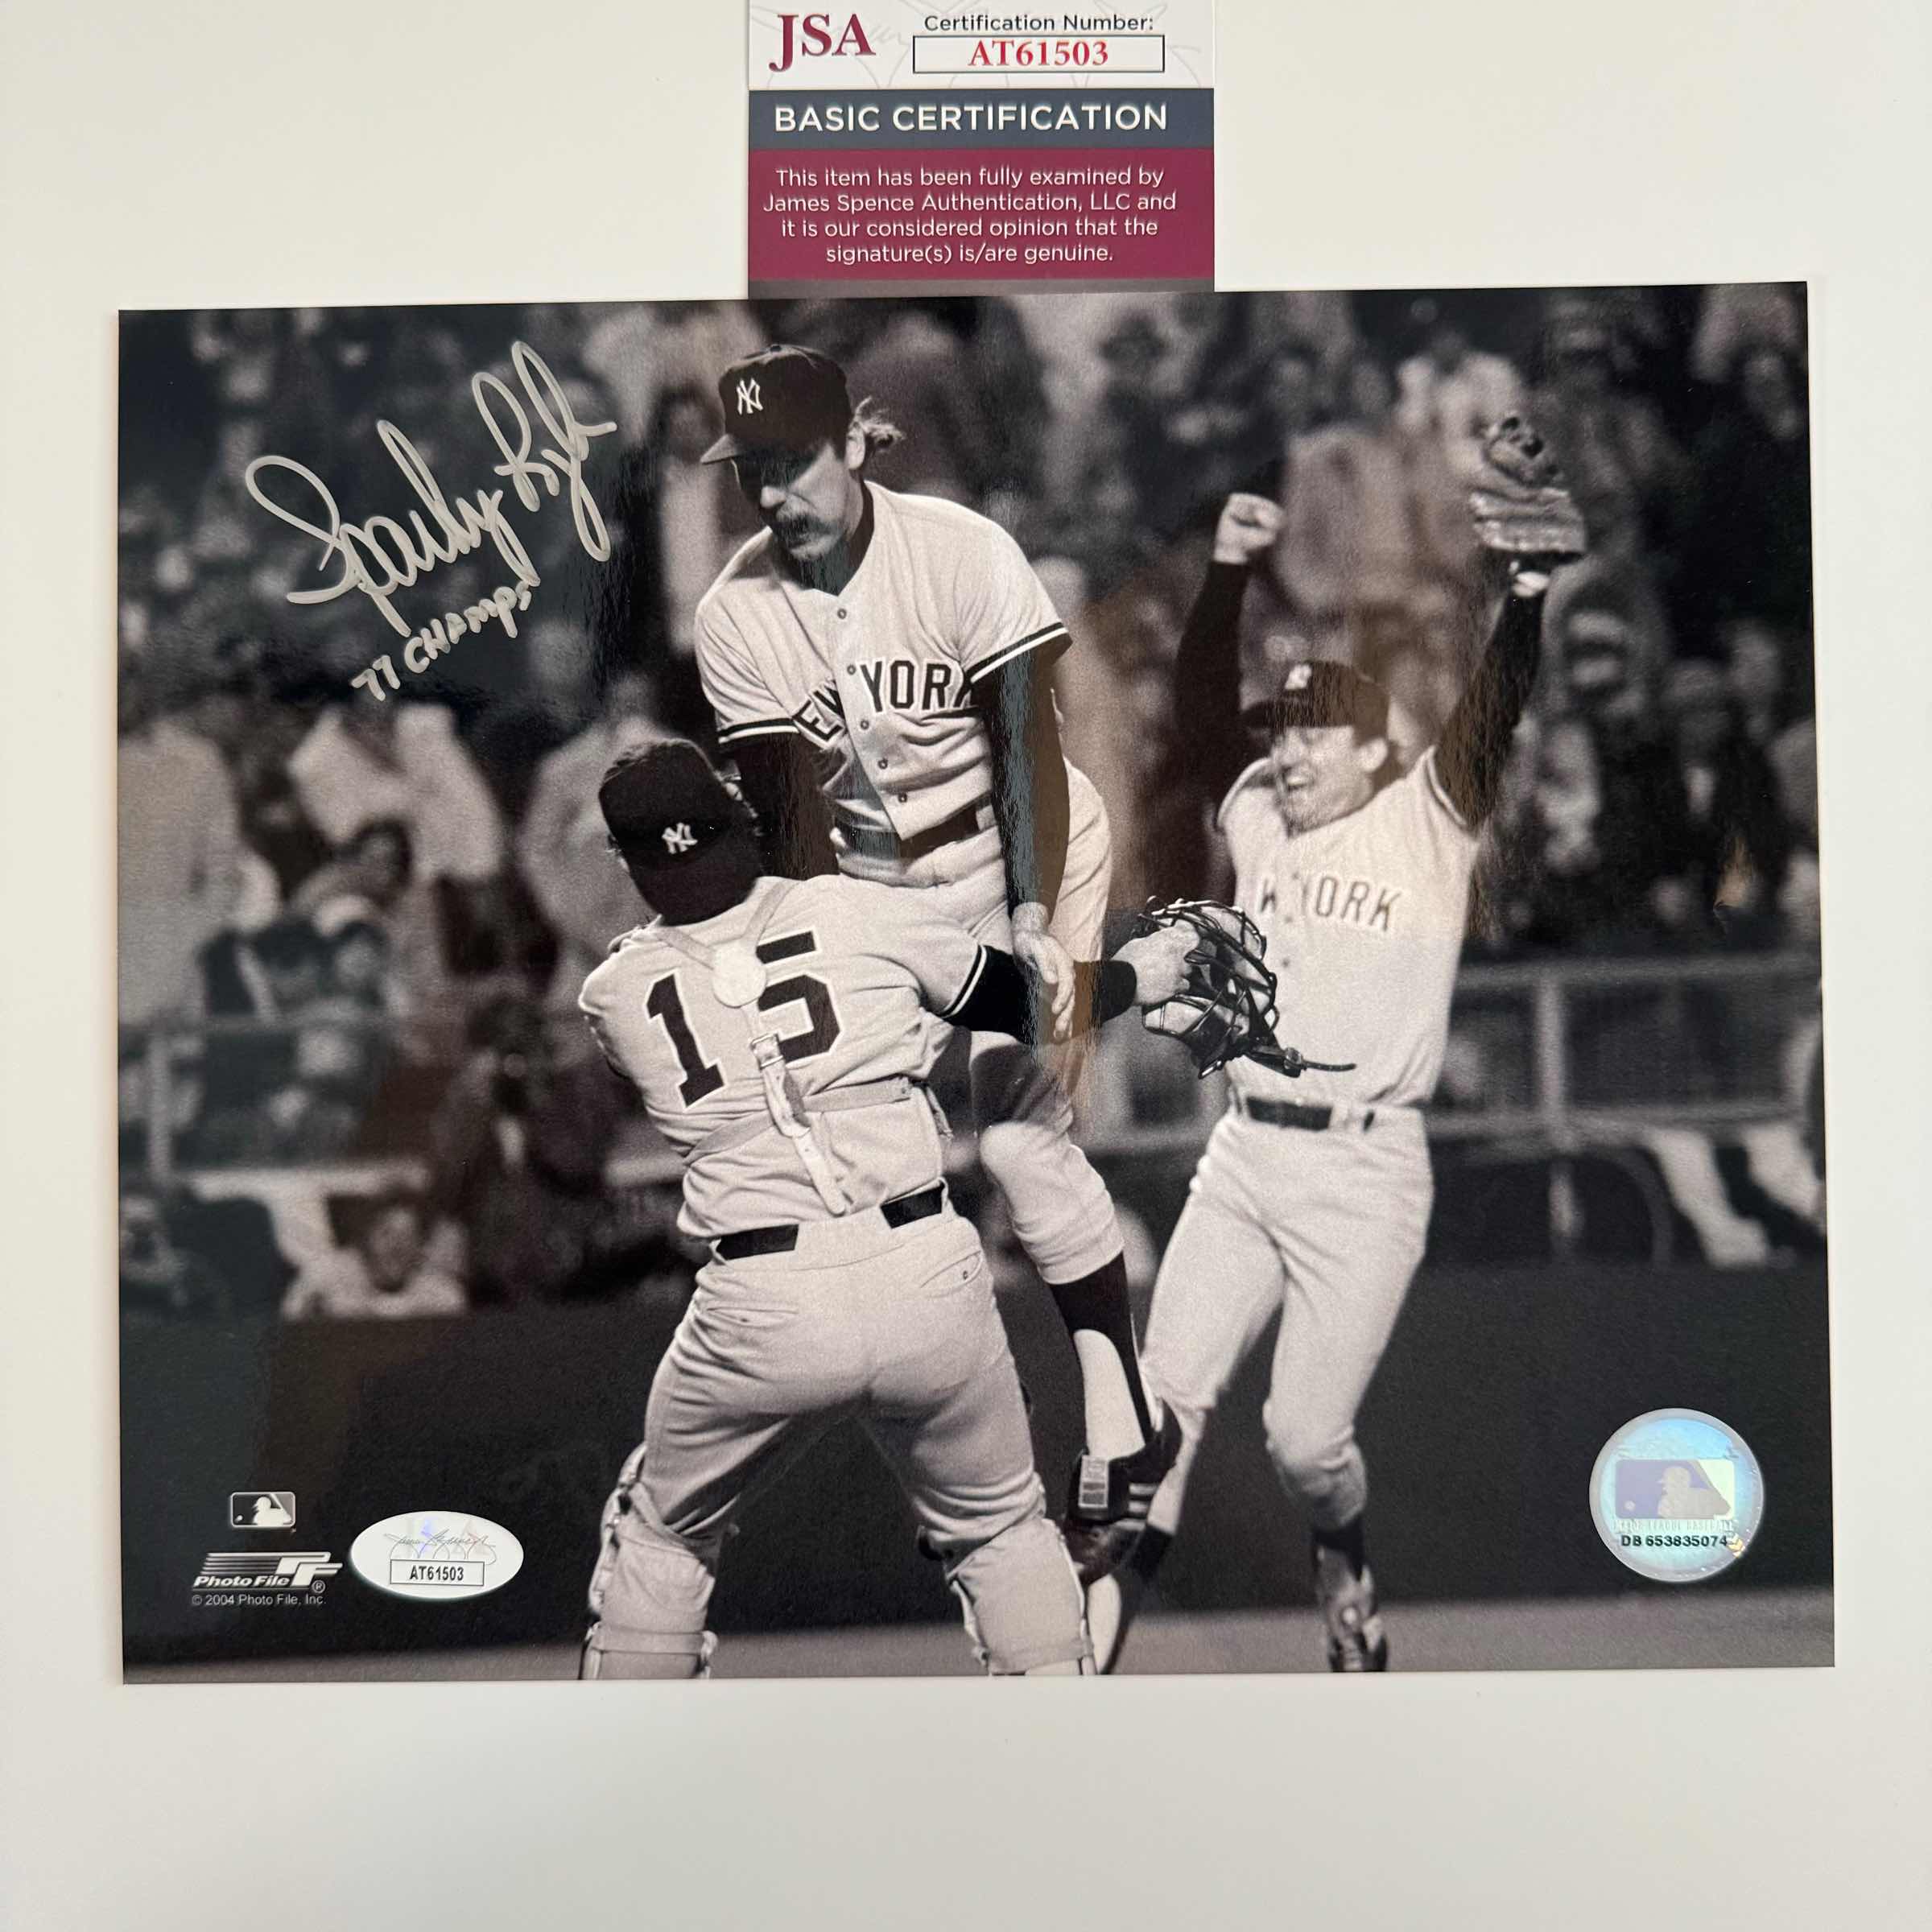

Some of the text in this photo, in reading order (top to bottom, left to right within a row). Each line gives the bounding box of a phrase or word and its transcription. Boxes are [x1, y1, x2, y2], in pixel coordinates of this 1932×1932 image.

[924, 14, 1154, 31] Certification Number:
[769, 13, 877, 72] JSA
[967, 40, 1109, 66] AT61503
[774, 103, 1167, 132] BASIC CERTIFICATION
[776, 165, 1164, 188] This item has been fully examined by
[763, 191, 1177, 214] James Spence Authentication, LLC and
[782, 216, 1158, 239] it is our considered opinion that the
[826, 242, 1113, 266] signature(s) is/are genuine.
[791, 675, 846, 748] EW
[646, 929, 842, 1109] 15
[1621, 1534, 1728, 1547] DB 653835074
[193, 1575, 252, 1587] Photo
[254, 1575, 290, 1587] File
[409, 1566, 464, 1581] AT61503
[205, 1595, 234, 1605] 2004
[238, 1594, 274, 1604] Photo
[277, 1594, 302, 1605] File,
[306, 1594, 327, 1604] Inc.
